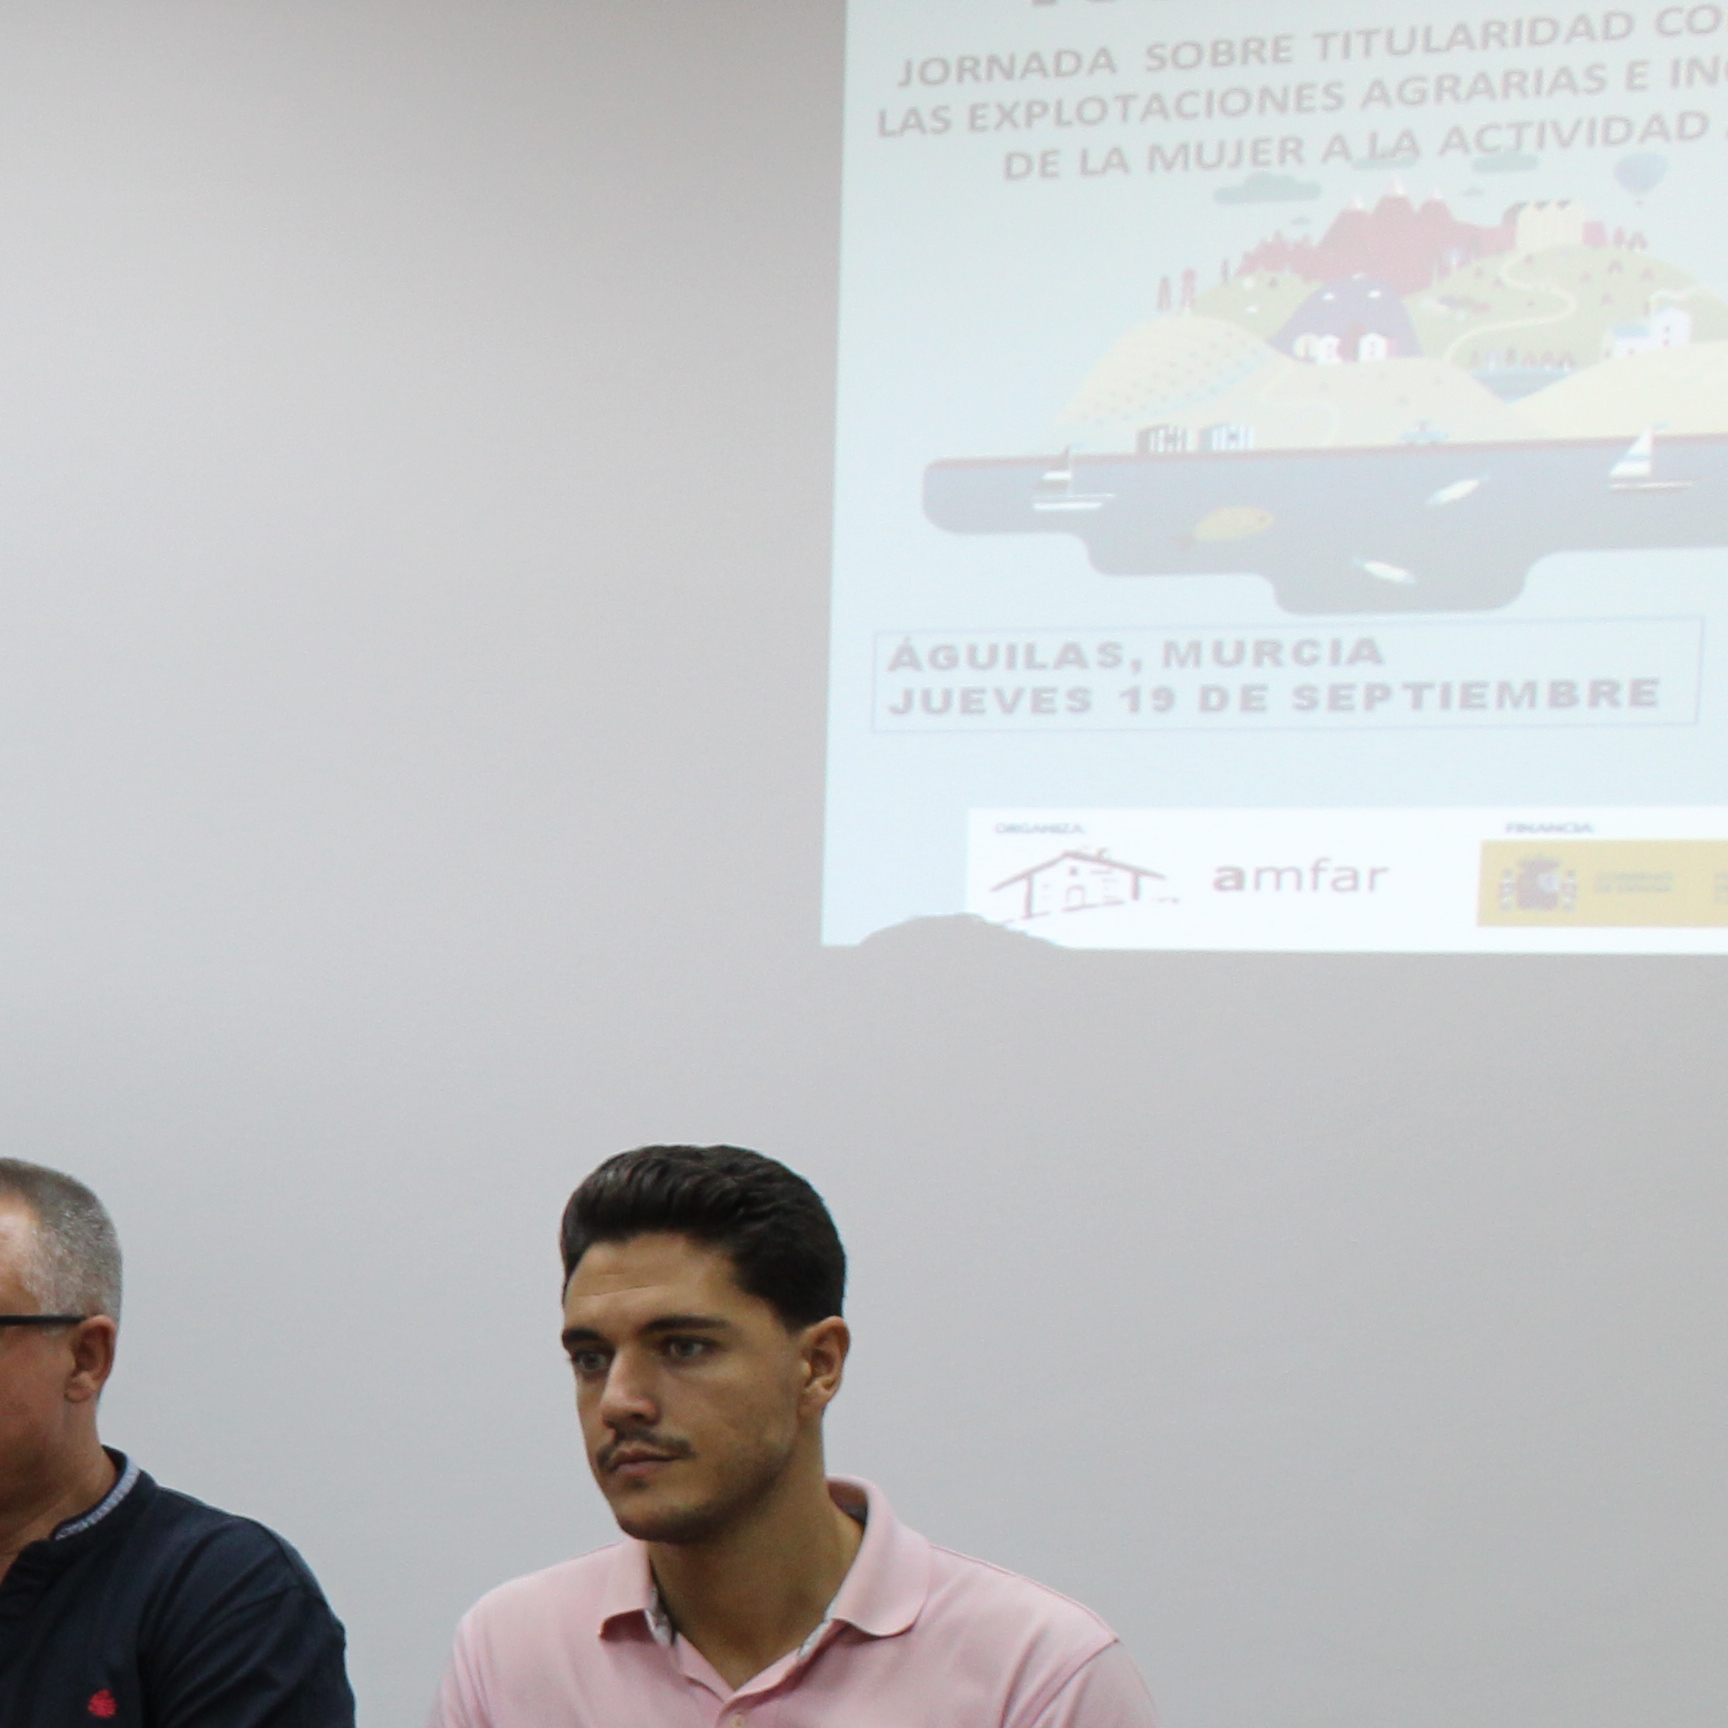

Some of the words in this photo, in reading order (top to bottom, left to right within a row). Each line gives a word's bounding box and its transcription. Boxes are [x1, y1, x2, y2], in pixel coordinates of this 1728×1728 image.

[898, 47, 1117, 88] JORNADA
[1145, 35, 1293, 72] SOBRE
[1314, 10, 1636, 61] TITULARIDAD
[1655, 3, 1728, 38] CO
[878, 104, 952, 137] LAS
[968, 80, 1344, 133] EXPLOTACIONES
[1362, 63, 1607, 111] AGRARIAS
[1626, 60, 1649, 91] E
[1670, 55, 1728, 88] IN
[1004, 150, 1060, 181] DE
[1079, 145, 1130, 177] LA
[1147, 136, 1305, 174] MUJER
[1322, 131, 1354, 164] A
[1369, 128, 1422, 161] LA
[1439, 109, 1710, 156] ACTIVIDAD
[887, 636, 1144, 674] ÁGUILAS,
[1162, 637, 1387, 669] MURCIA
[888, 686, 1094, 716] JUEVES
[1120, 685, 1176, 715] 19
[1199, 683, 1270, 714] DE
[1293, 678, 1661, 712] SEPTIEMBRE
[1213, 857, 1390, 893] amfar
